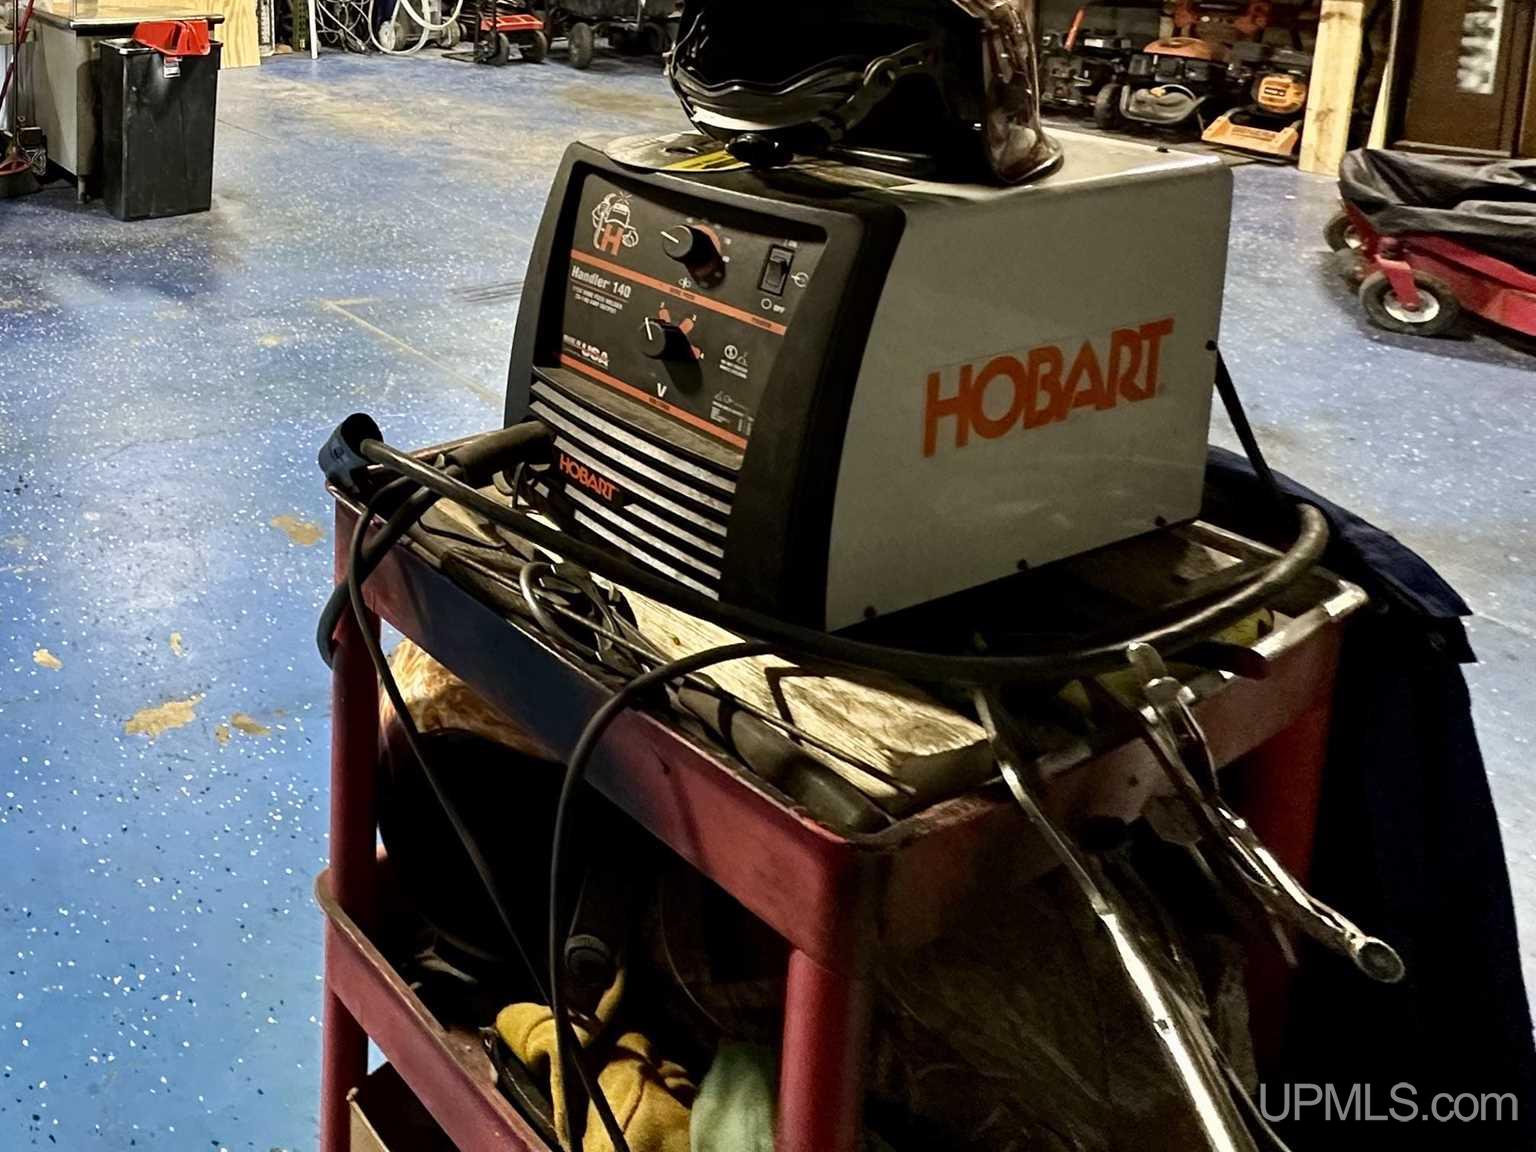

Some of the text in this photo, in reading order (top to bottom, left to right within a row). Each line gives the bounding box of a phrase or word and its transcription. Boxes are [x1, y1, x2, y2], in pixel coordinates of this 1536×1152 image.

[571, 265, 610, 289] Handler
[613, 281, 632, 298] 140
[581, 342, 609, 367] USA
[923, 318, 1175, 458] HOBART
[559, 453, 617, 501] HOBART
